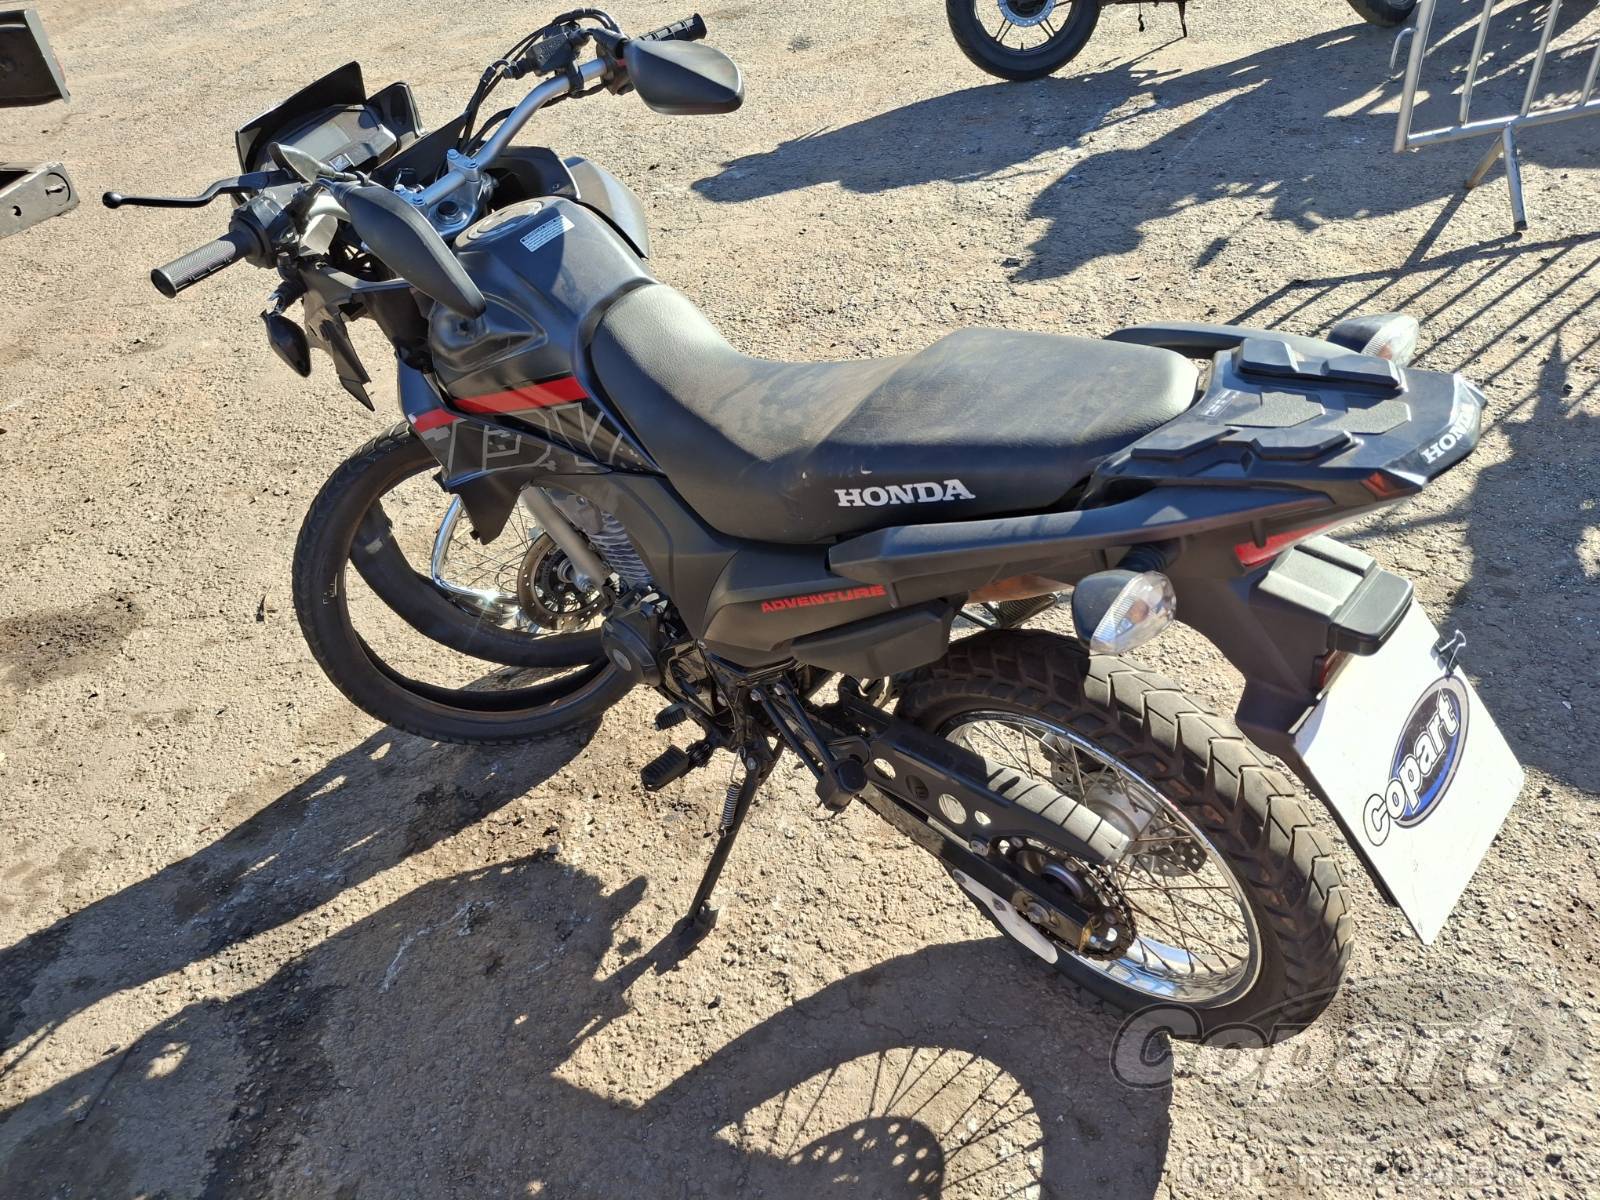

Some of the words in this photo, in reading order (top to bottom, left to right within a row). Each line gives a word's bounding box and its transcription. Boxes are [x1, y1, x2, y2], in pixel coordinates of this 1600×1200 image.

[834, 478, 976, 507] HONDA
[760, 584, 887, 613] ADVENTURE
[1363, 688, 1459, 847] Copart
